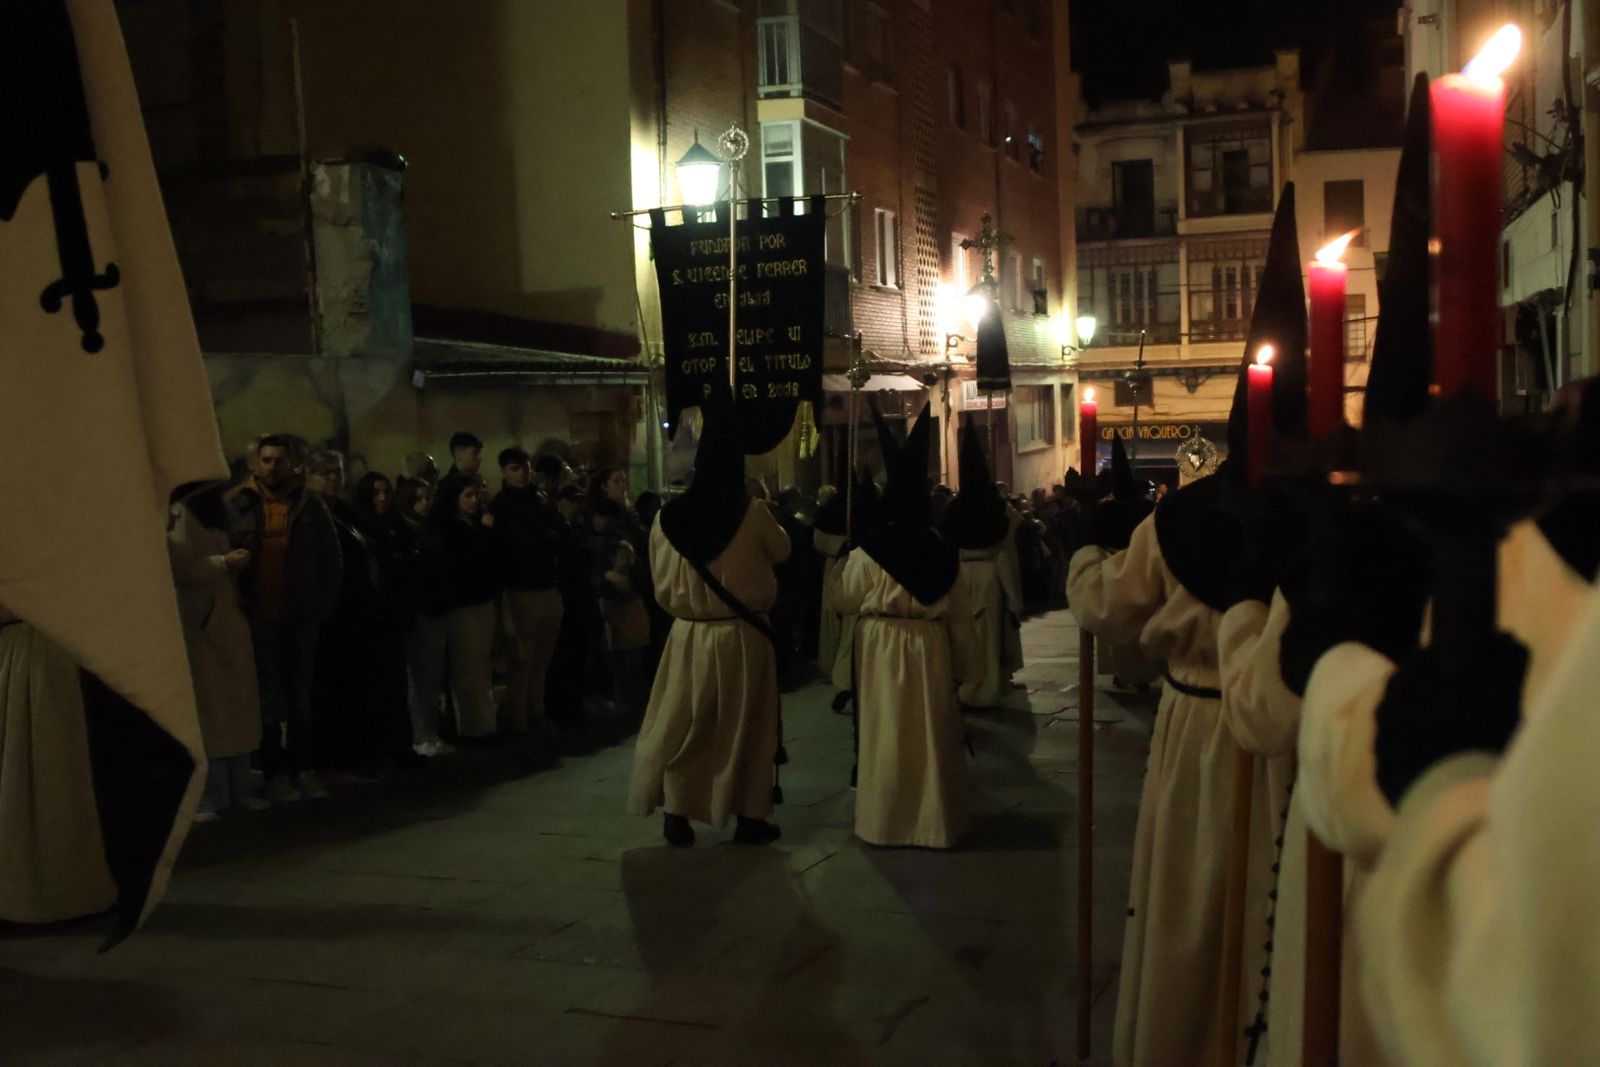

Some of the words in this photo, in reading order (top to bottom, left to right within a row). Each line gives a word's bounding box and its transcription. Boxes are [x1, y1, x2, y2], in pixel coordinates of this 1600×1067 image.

[759, 232, 786, 251] POR
[687, 263, 748, 283] VICENE
[757, 259, 808, 278] FERRER
[730, 327, 776, 345] ELIPE
[763, 352, 812, 371] TITULO
[766, 381, 800, 399] 2018
[1102, 427, 1135, 440] GACIA
[1138, 425, 1191, 440] VAQUERO
